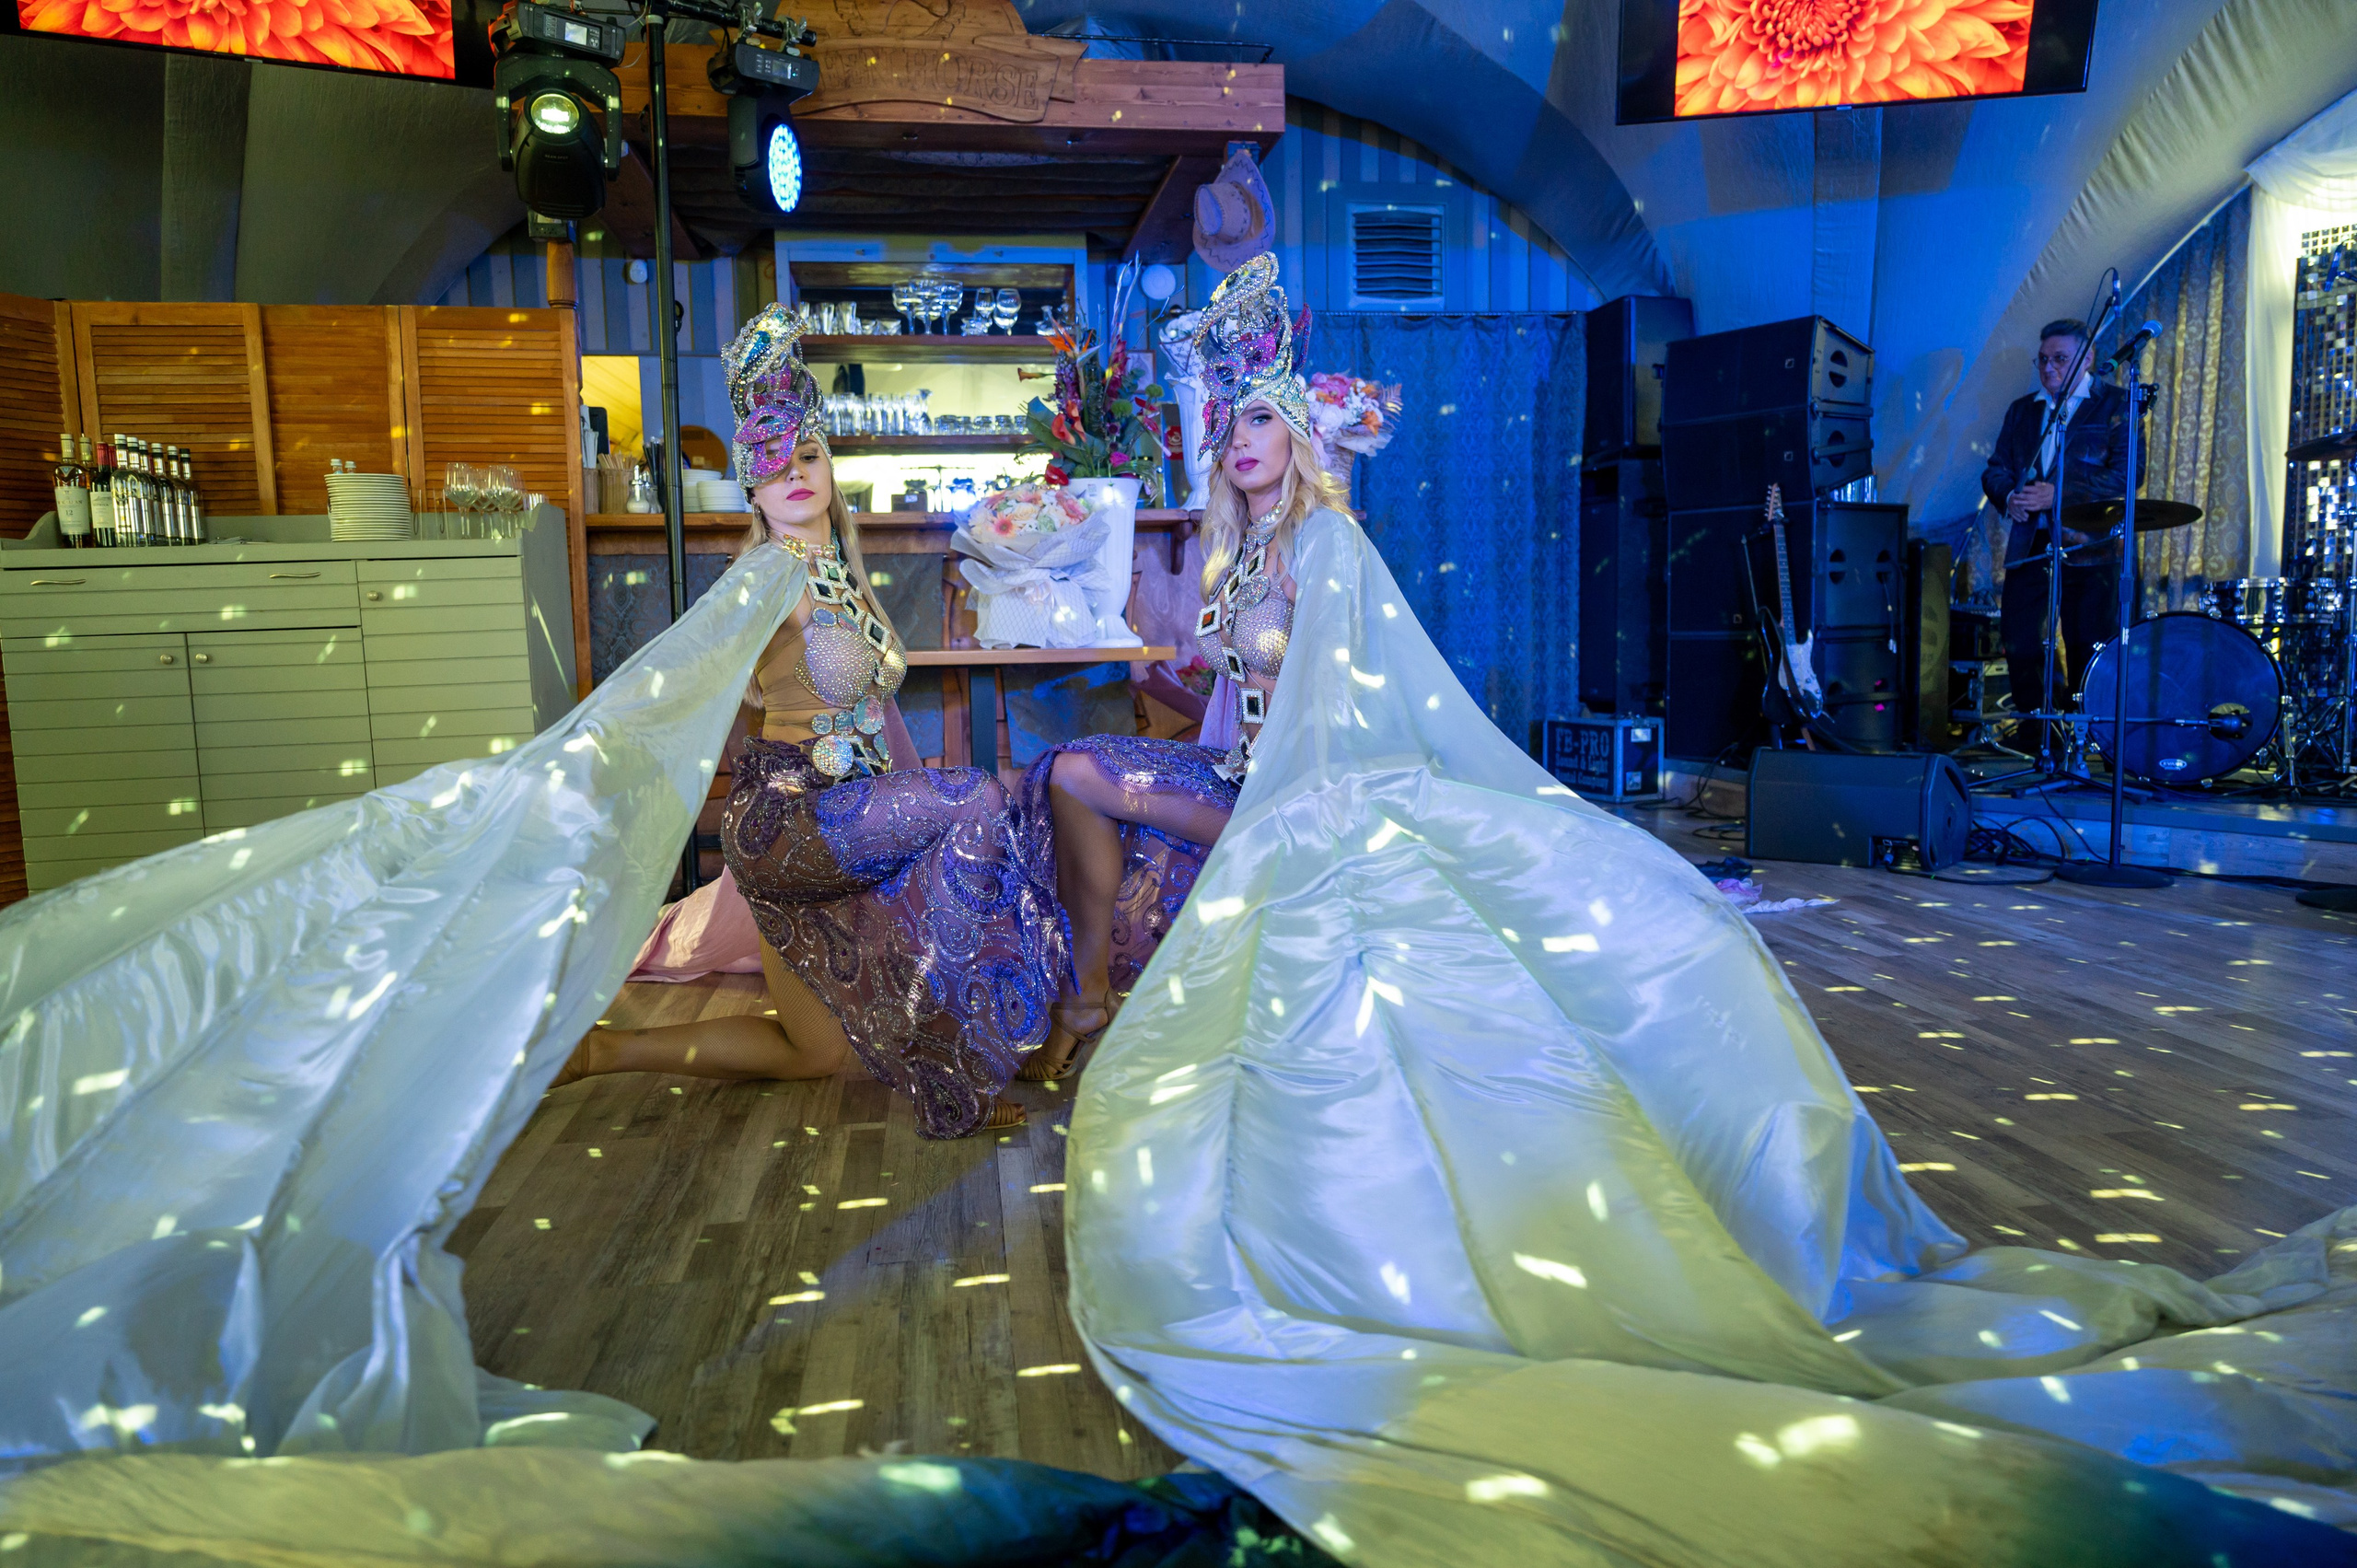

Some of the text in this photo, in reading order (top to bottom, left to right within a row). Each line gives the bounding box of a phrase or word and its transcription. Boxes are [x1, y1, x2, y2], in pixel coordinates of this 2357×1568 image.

[904, 48, 1039, 110] HORSE
[1555, 727, 1609, 758] FB-PRO
[1555, 752, 1608, 775] Sound & Light
[1555, 768, 1609, 790] Rental Company
